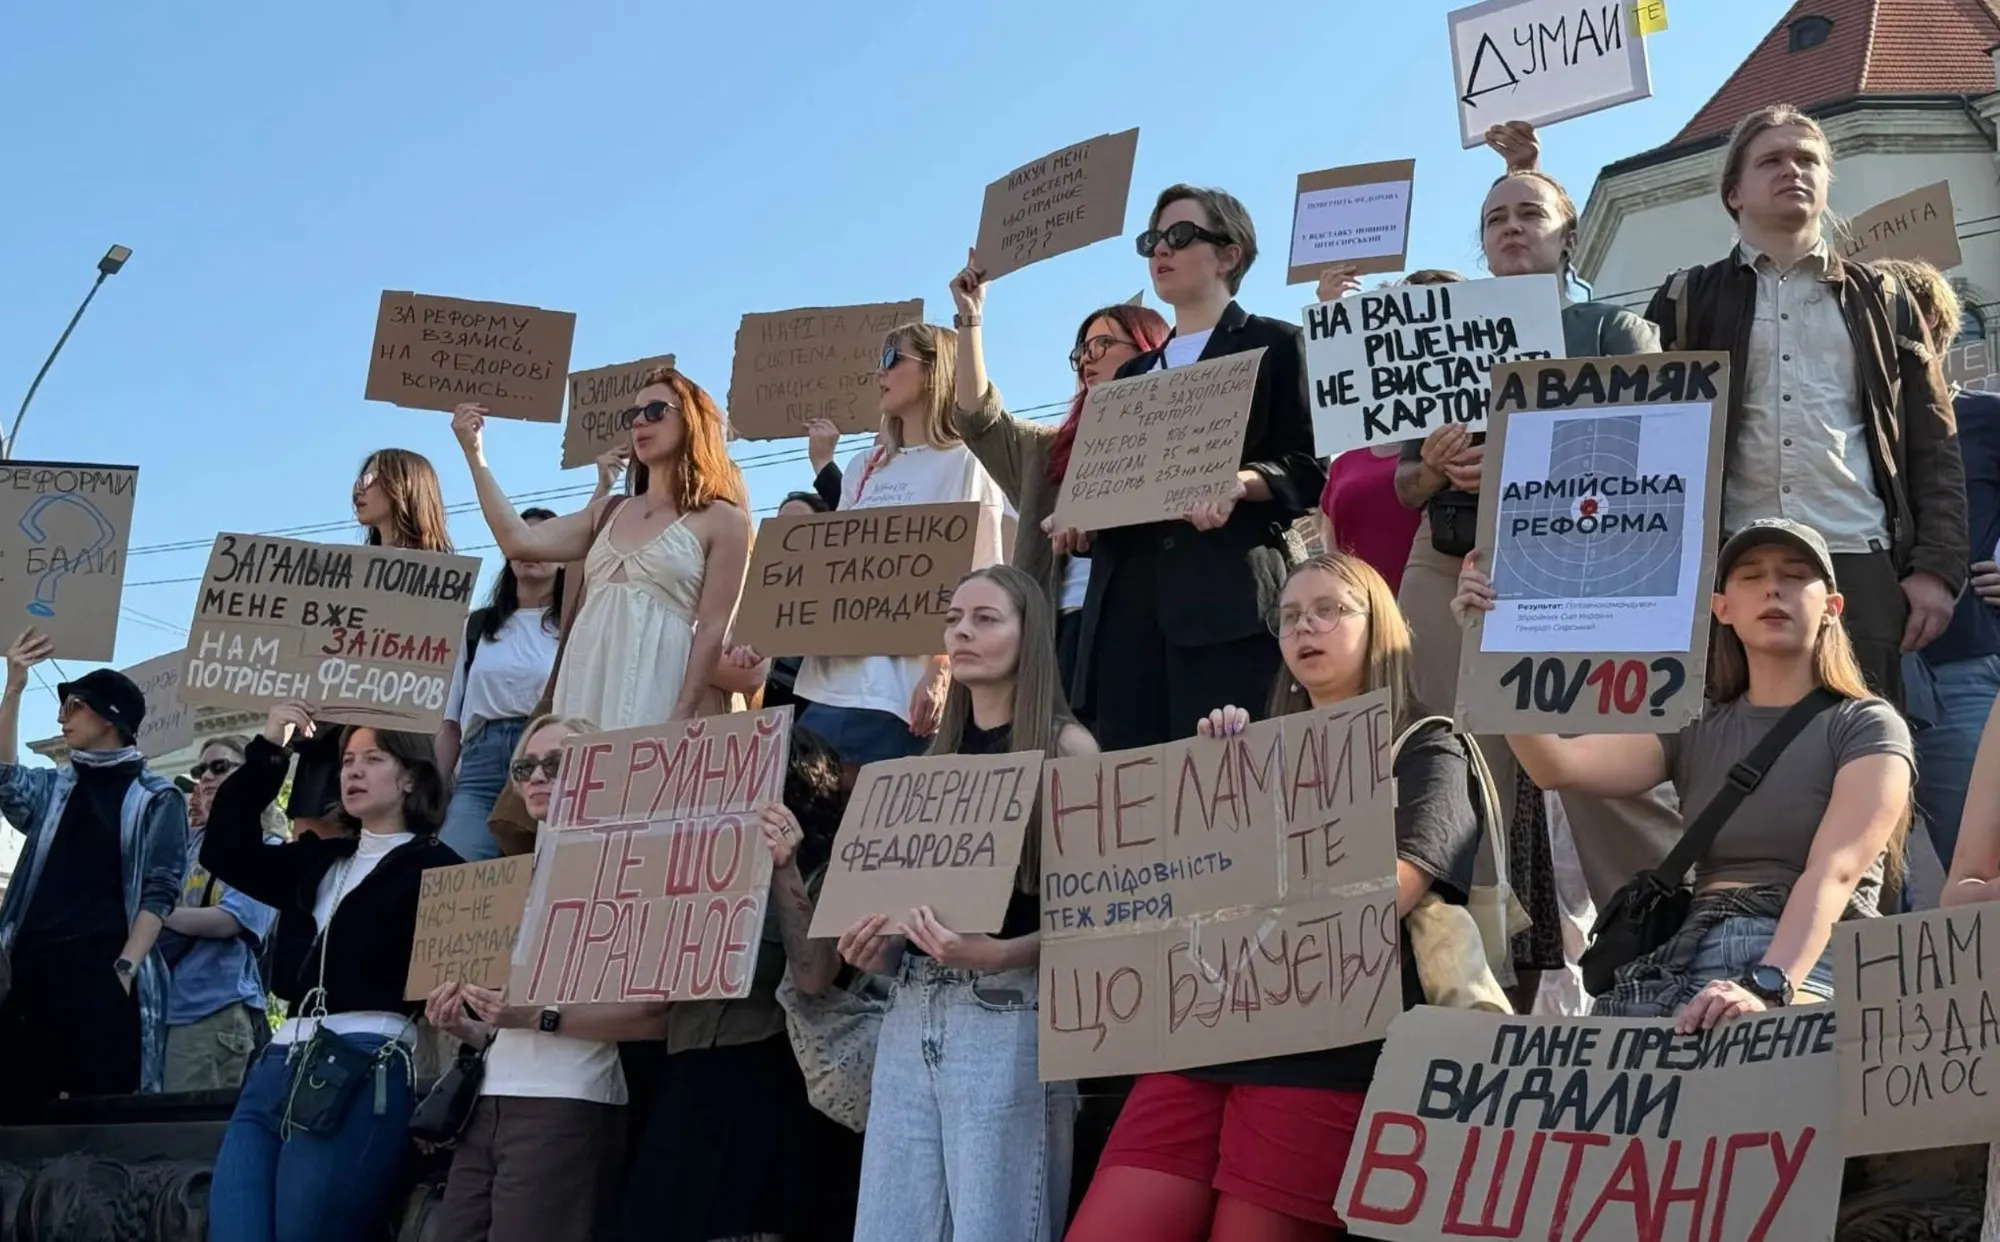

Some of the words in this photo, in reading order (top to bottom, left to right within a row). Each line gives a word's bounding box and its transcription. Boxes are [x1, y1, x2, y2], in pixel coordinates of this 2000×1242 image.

[1632, 2, 1661, 23] ТЕ
[1053, 145, 1090, 171] МЕНІ
[1001, 224, 1038, 252] ПРОТИ
[1045, 205, 1085, 230] МЕНЕ
[1844, 202, 1937, 258] ШТАНГА
[391, 306, 416, 323] ЗА
[423, 309, 531, 335] РЕФОРМУ
[1308, 302, 1352, 340] НА
[1362, 287, 1451, 330] ВАШІ
[380, 344, 411, 359] НА
[431, 350, 553, 380] ФЕДОРОВІ
[1365, 317, 1519, 367] РІШЕННЯ
[1228, 359, 1253, 376] НА
[1316, 370, 1359, 407] НЕ
[1363, 387, 1490, 440] КАРТОН
[1495, 371, 1528, 412] А
[1084, 432, 1148, 457] УМЕРОВ
[1502, 472, 1685, 503] АРМІЙСЬКА
[782, 514, 969, 553] СТЕРНЕНКО
[1511, 512, 1669, 538] РЕФОРМА
[213, 535, 353, 589] ЗАГАЛЬНА
[363, 557, 473, 604] ПОПЛАВА
[763, 560, 804, 589] БИ
[825, 553, 934, 585] ТАКОГО
[201, 589, 288, 619] МЕНЕ
[301, 601, 368, 630] ВЖЕ
[775, 600, 819, 629] НЕ
[1517, 602, 1564, 612] Результат:
[199, 630, 280, 665] НАМ
[321, 627, 451, 665] ЗАЇБАЛА
[186, 659, 310, 699] ПОТРІБЕН
[317, 657, 446, 710] ФЕДОРОВ
[1499, 654, 1687, 717] 10/10?
[550, 742, 614, 828] НЕ
[620, 711, 786, 824] РУЙНУЙ
[1050, 756, 1157, 857] НЕ
[1173, 702, 1392, 837] ЛАМАЙТЕ
[859, 766, 1025, 830] ПОВЕРНІТЬ
[591, 820, 652, 900] ТЕ
[840, 831, 996, 872] ФЕДОРОВА
[1288, 817, 1349, 880] ТЕ
[421, 869, 466, 899] БУЛО
[472, 860, 517, 888] МАЛО
[1045, 851, 1233, 902] ПОСЛІДОВНІСТЬ
[1045, 905, 1096, 930] ТЕЖ
[1103, 892, 1174, 927] ЗБРОЯ
[432, 956, 496, 985] ТЕКСТ
[527, 896, 759, 1003] ПРАЦЮЄ
[1855, 911, 1983, 1001] НАМ
[1050, 964, 1144, 1053] ЩО
[1166, 899, 1401, 1035] БУДУЄТЬСЯ
[1491, 1024, 1601, 1069] ПАНЕ
[1607, 1011, 1837, 1070] ПРЕЗИДЕНТЕ
[1417, 1058, 1682, 1139] ВИДАЛИ
[1862, 1057, 1988, 1116] ГОЛОС
[1346, 1111, 1429, 1226] В
[1441, 1126, 1816, 1242] ШТАНГУ
